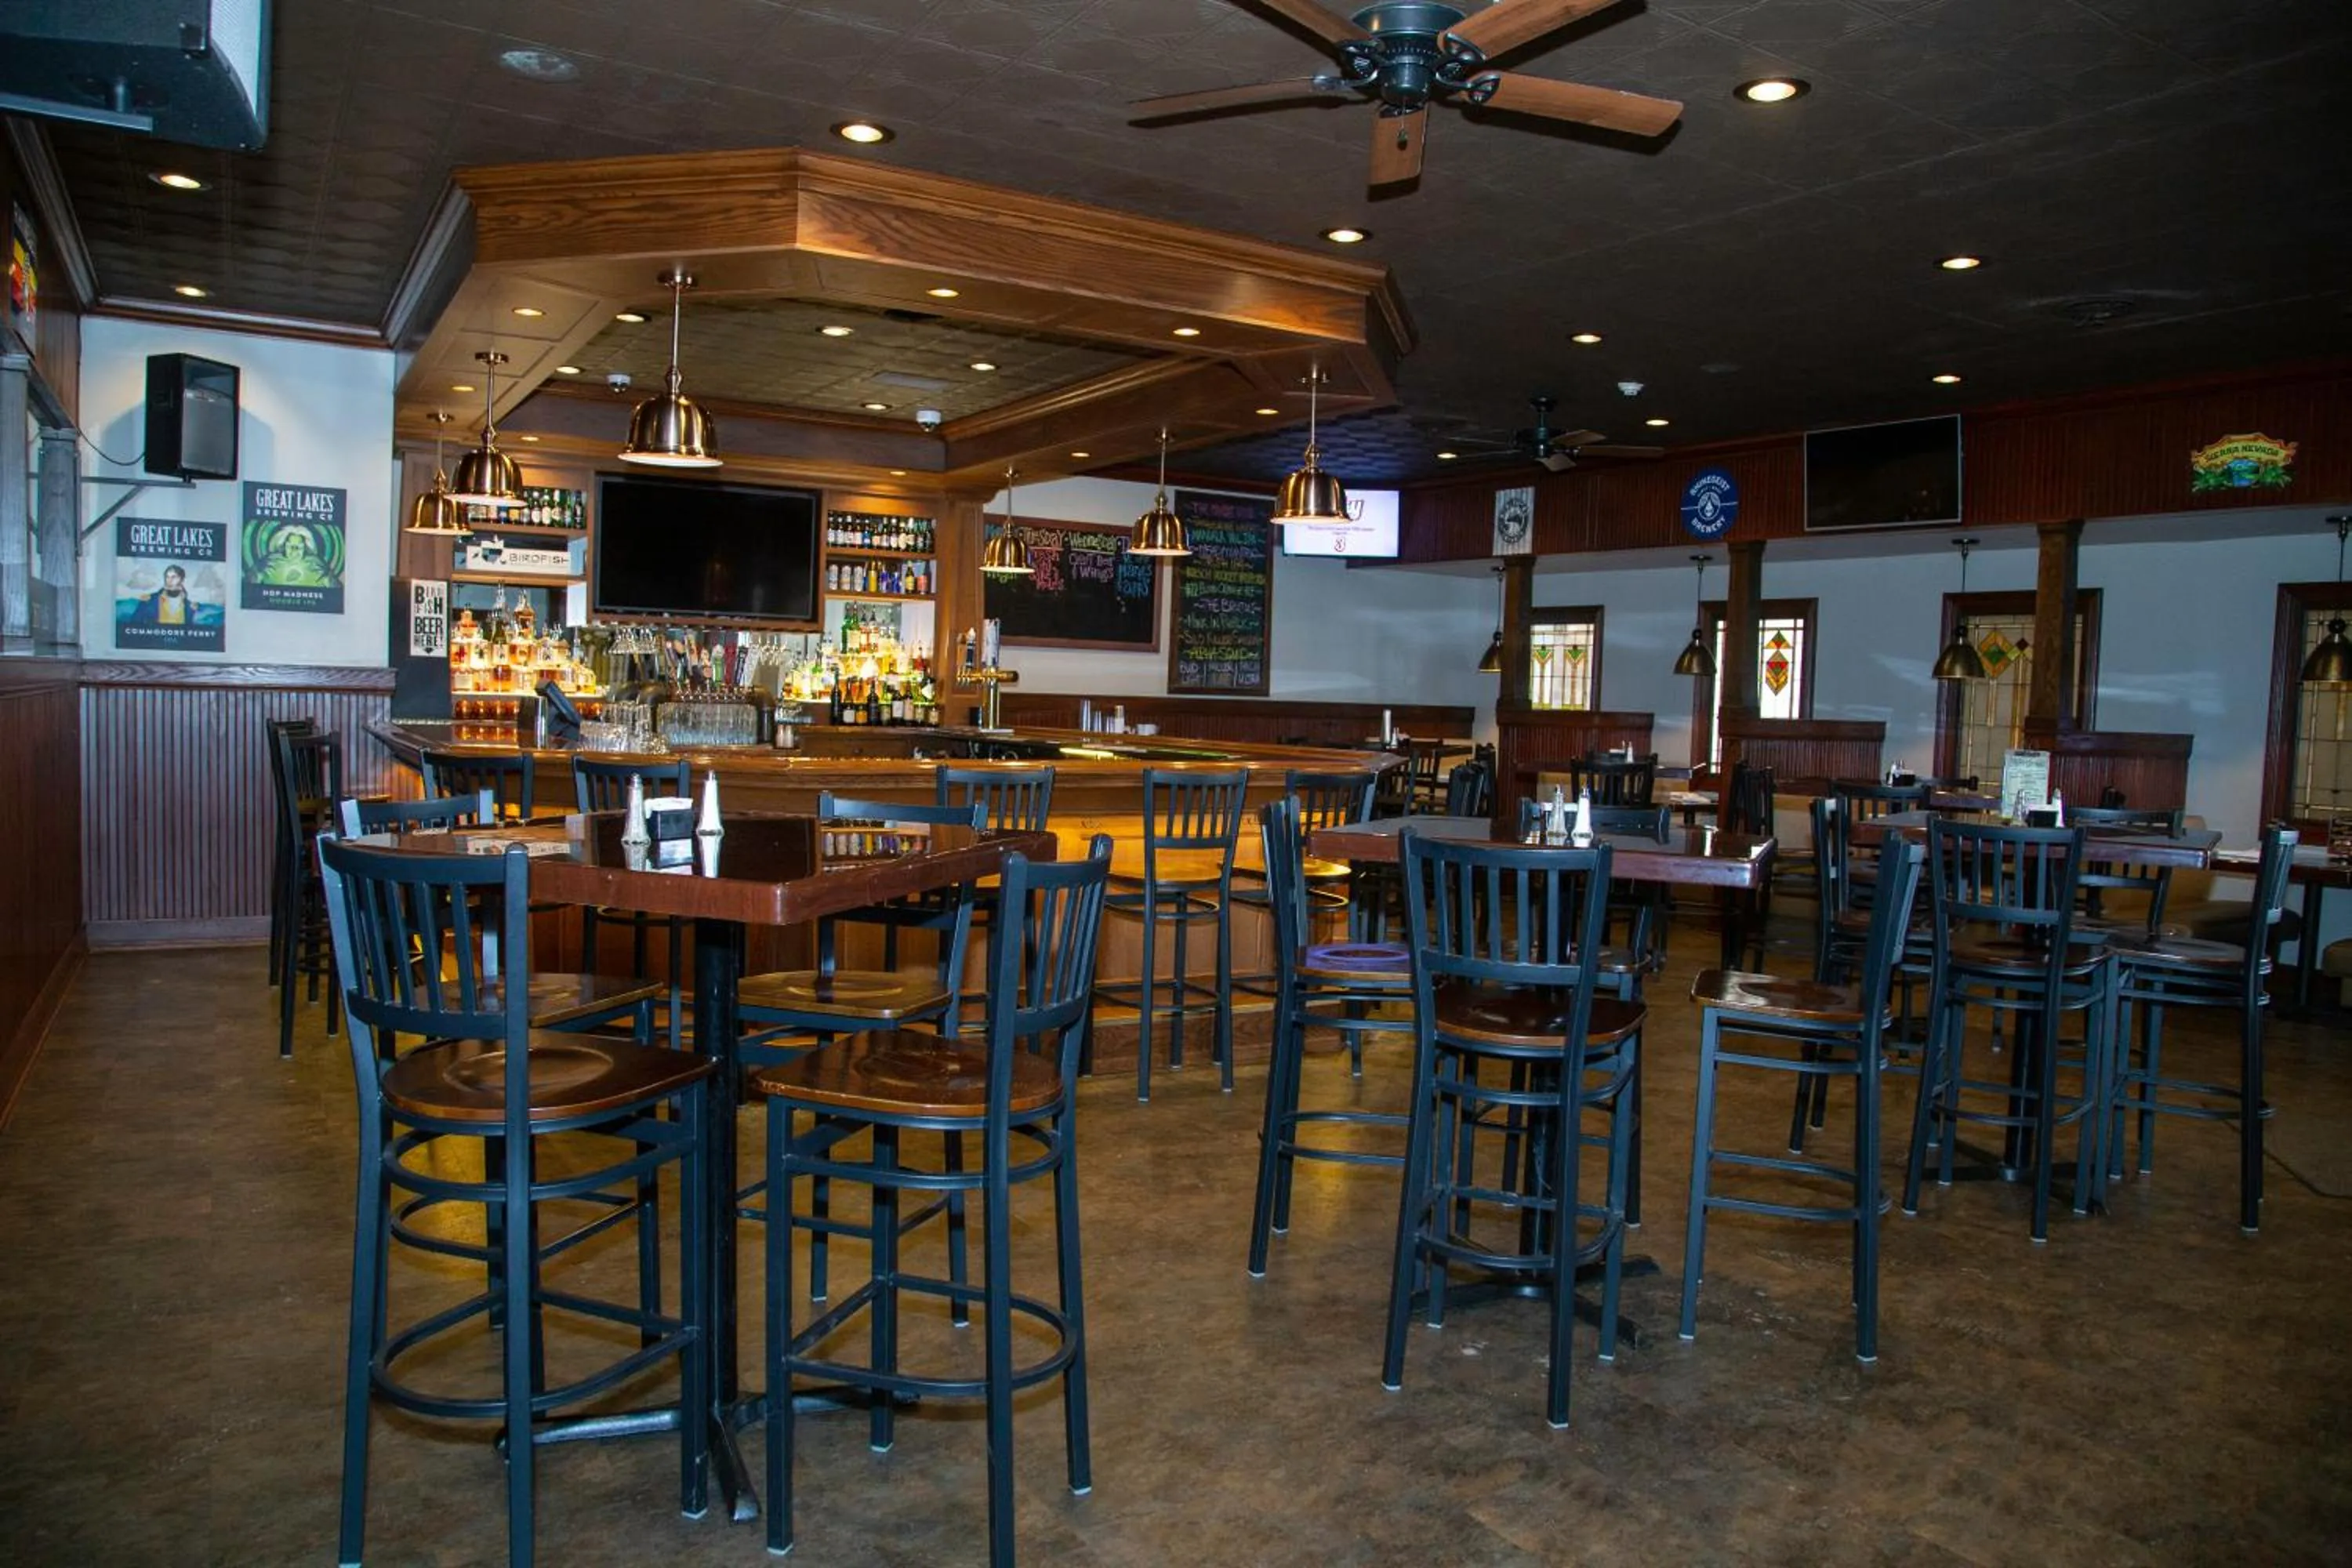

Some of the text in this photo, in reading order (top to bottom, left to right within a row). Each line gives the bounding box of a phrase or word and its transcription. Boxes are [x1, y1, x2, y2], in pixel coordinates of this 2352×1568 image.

[256, 488, 334, 512] GREAT LAKES
[256, 509, 313, 520] BREWING
[131, 524, 213, 548] GREAT LAKES
[131, 545, 191, 556] BREWING
[415, 616, 443, 634] BEER
[125, 628, 185, 637] COMMODORE
